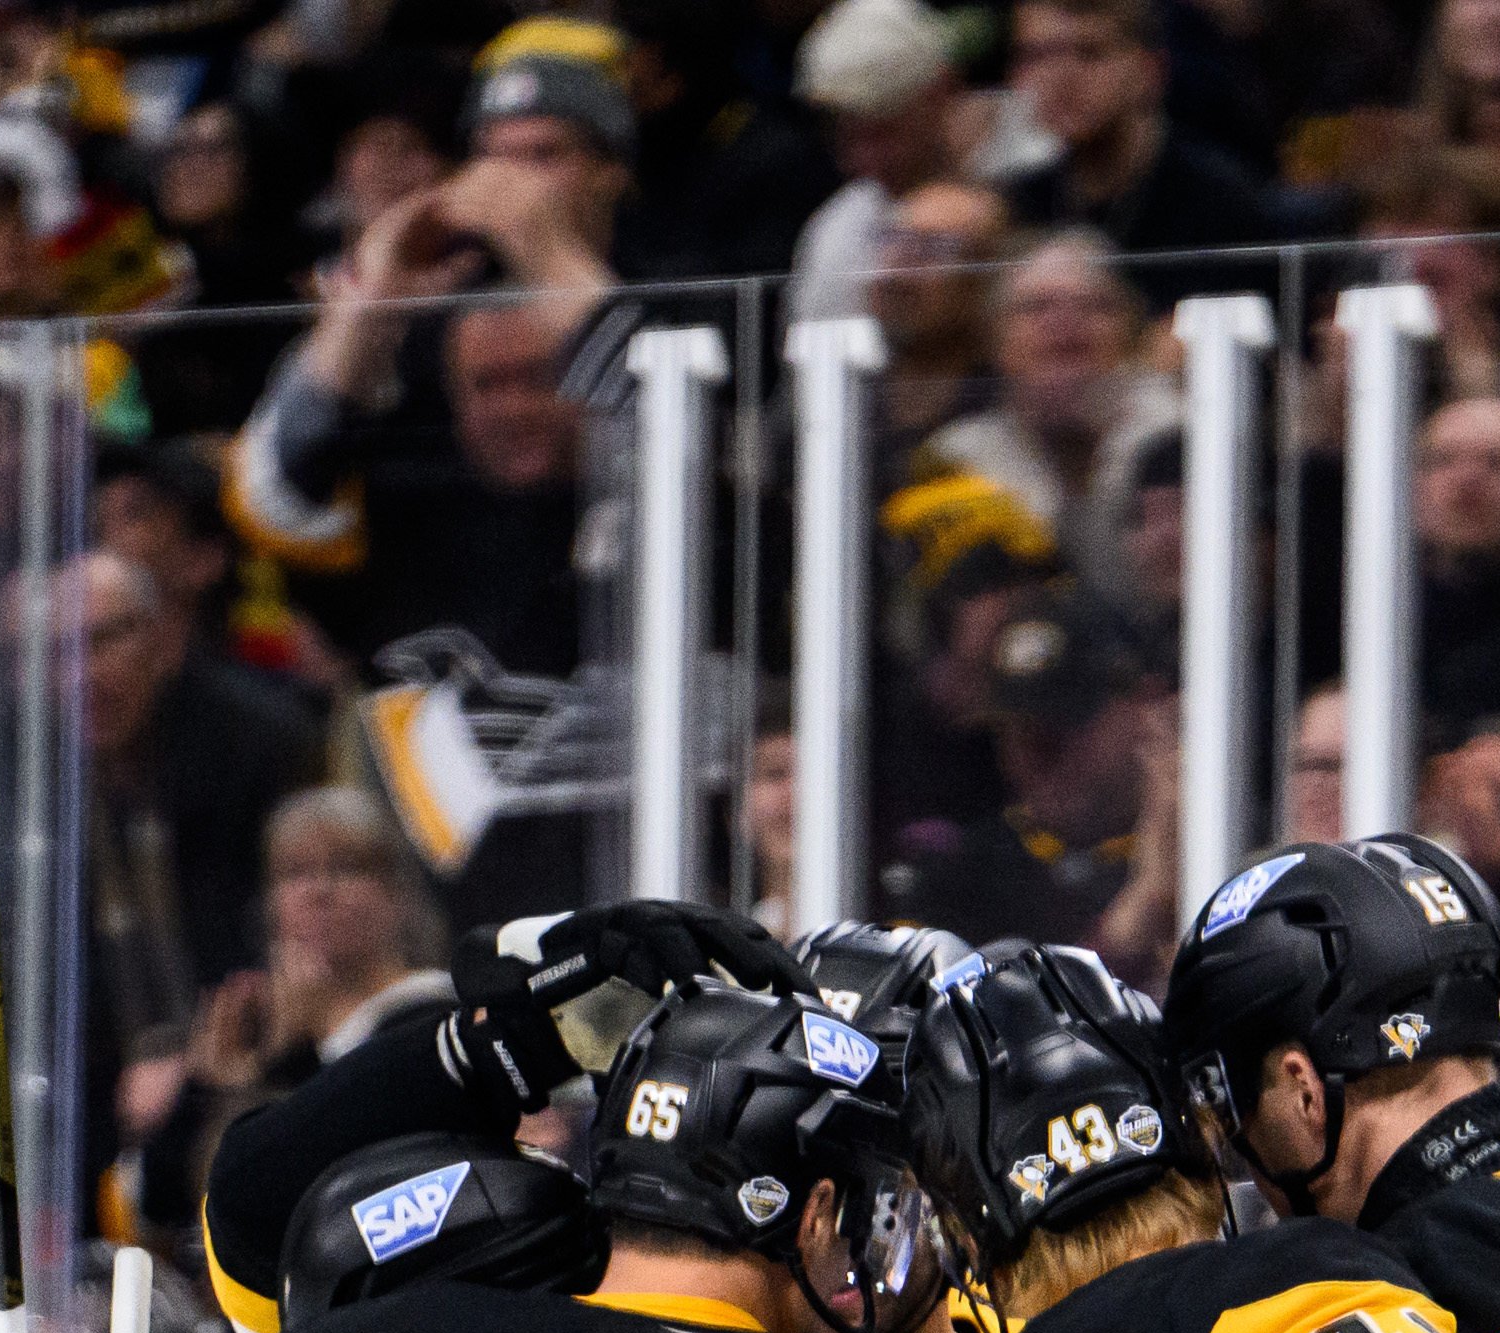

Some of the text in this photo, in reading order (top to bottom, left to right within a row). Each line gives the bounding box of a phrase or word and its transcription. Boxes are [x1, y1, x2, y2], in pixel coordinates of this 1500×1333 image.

[1209, 869, 1270, 921] SAP
[1405, 876, 1469, 926] 15
[808, 1024, 870, 1073] SAP
[626, 1079, 690, 1142] 65
[1047, 1103, 1119, 1173] 43
[363, 1183, 448, 1247] SAP
